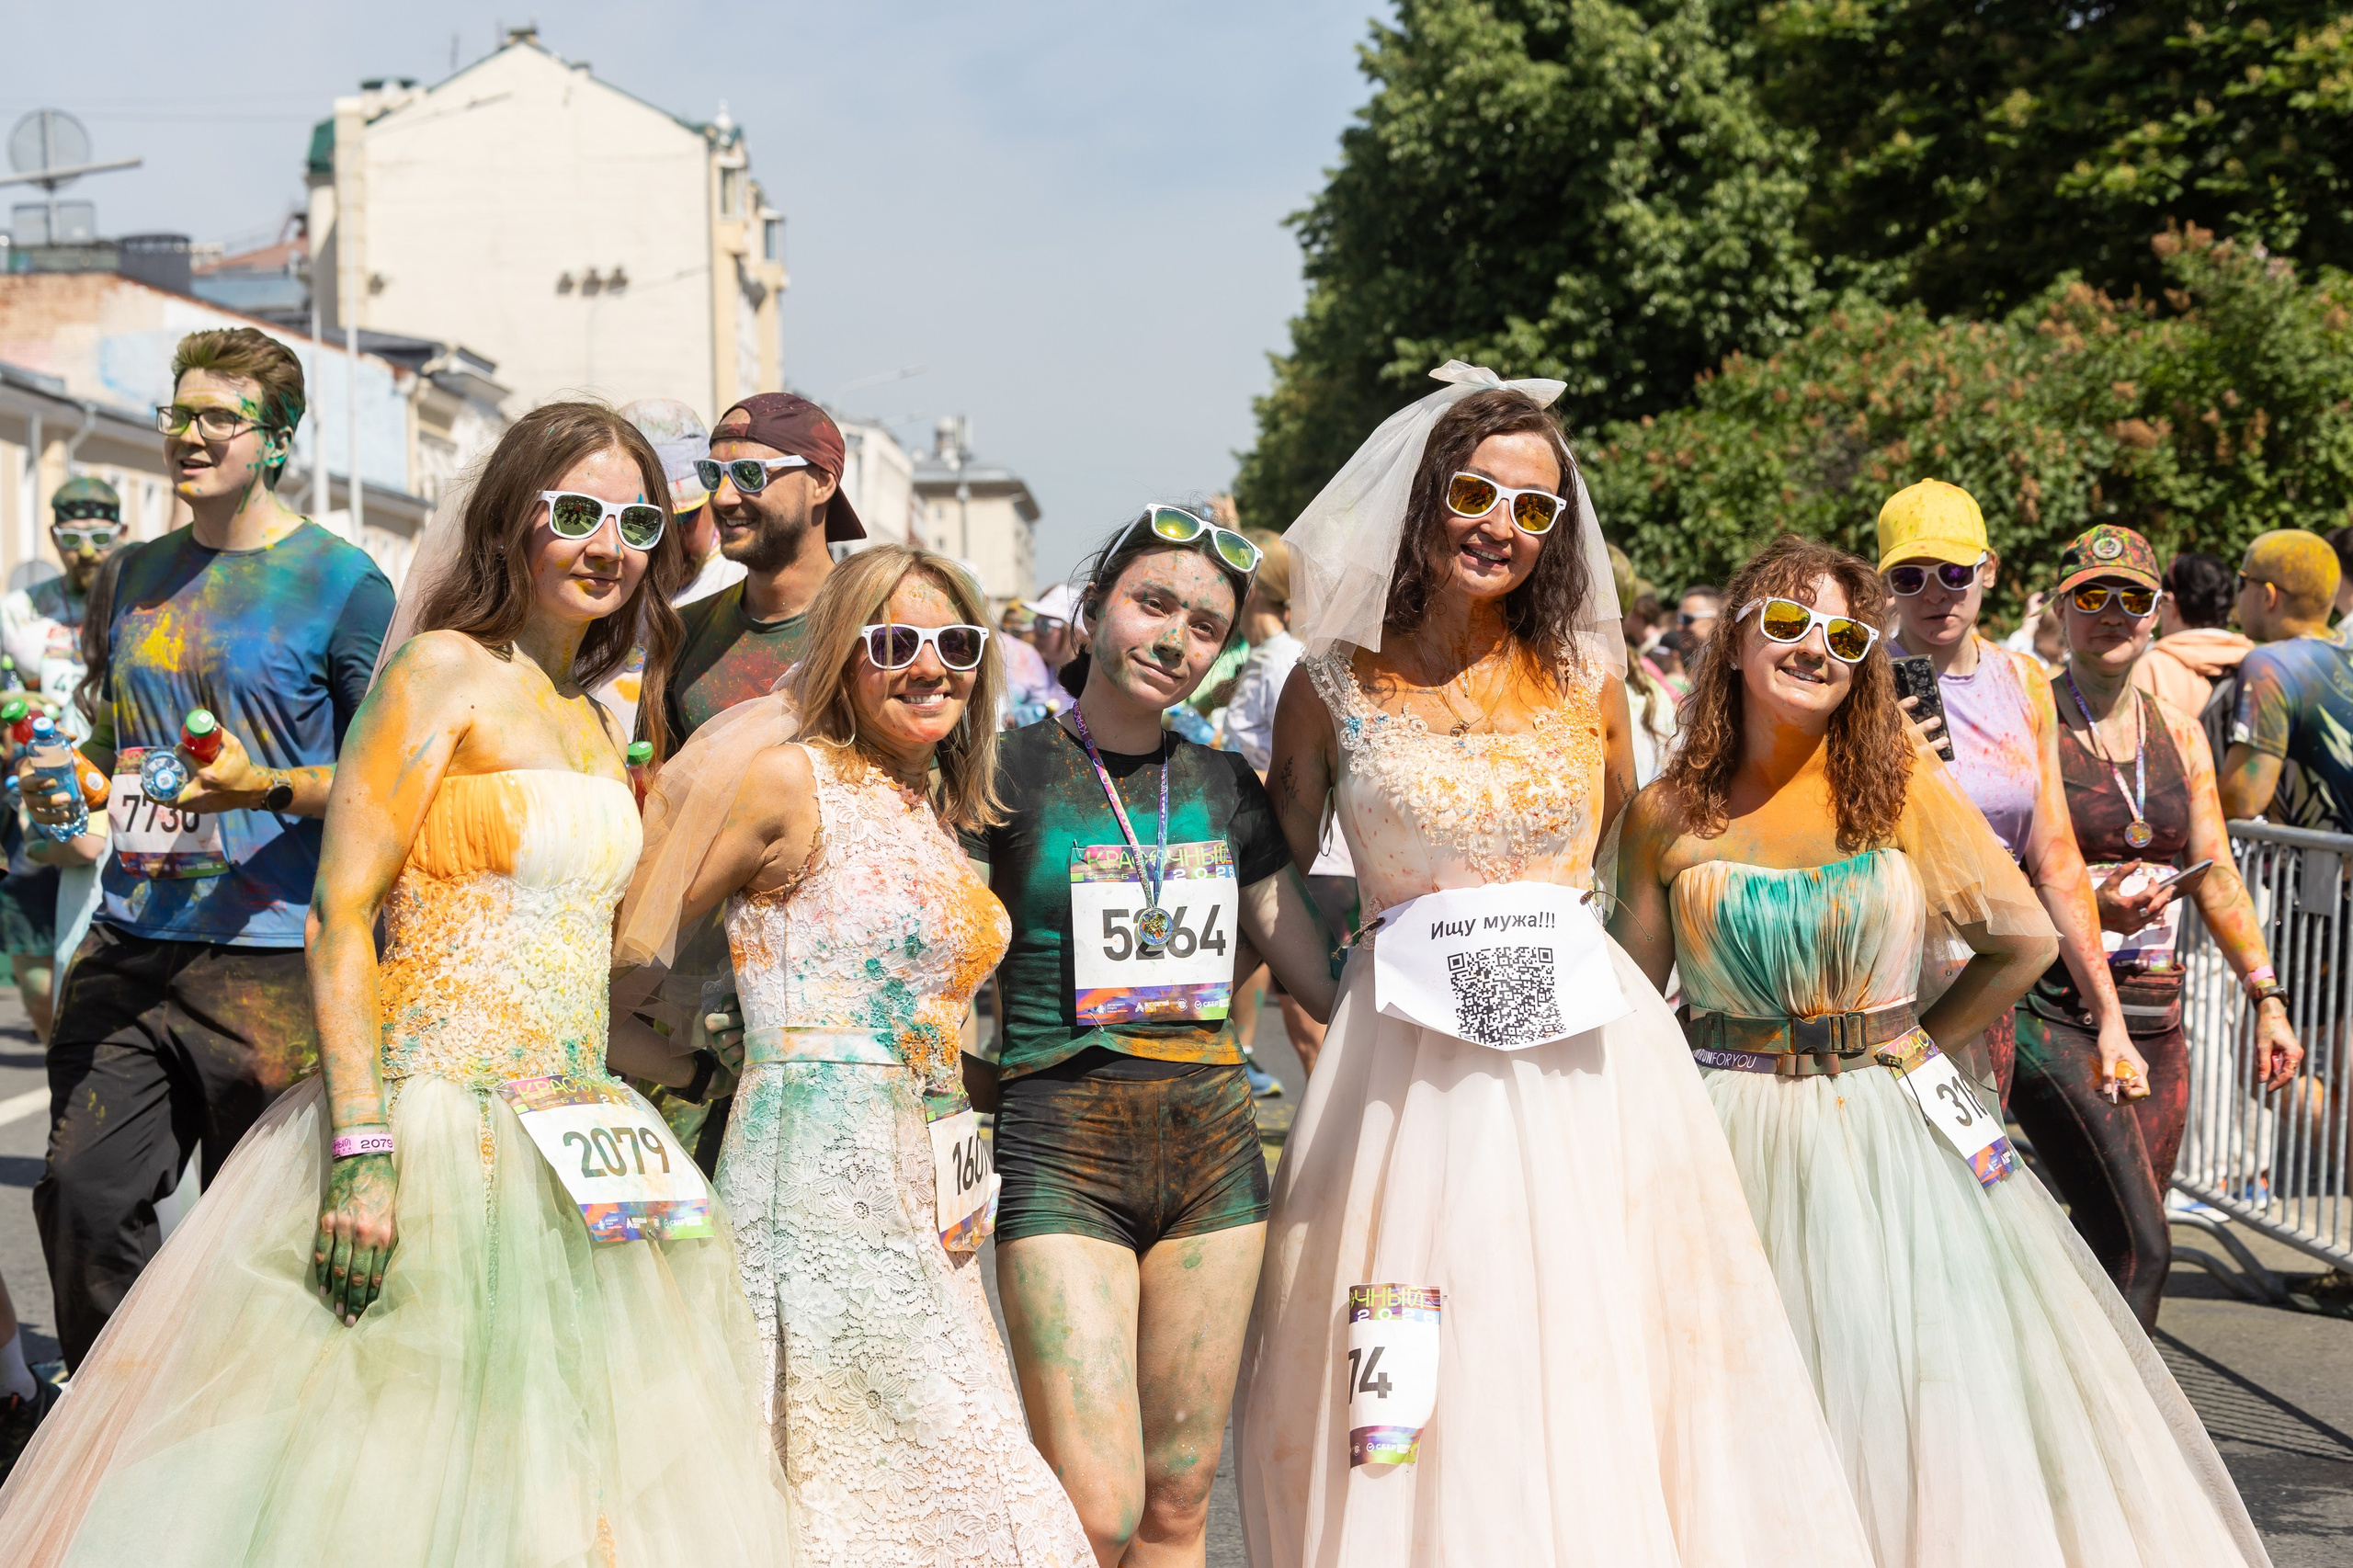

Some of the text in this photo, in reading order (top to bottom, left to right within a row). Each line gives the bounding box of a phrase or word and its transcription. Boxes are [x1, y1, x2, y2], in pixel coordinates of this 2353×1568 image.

[1172, 865, 1235, 881] 2026
[1102, 903, 1227, 961] 5264
[1430, 911, 1556, 940] Ищу мужа!!!
[360, 1138, 393, 1150] 2079
[563, 1127, 671, 1178] 2079
[1357, 1307, 1437, 1323] 2026
